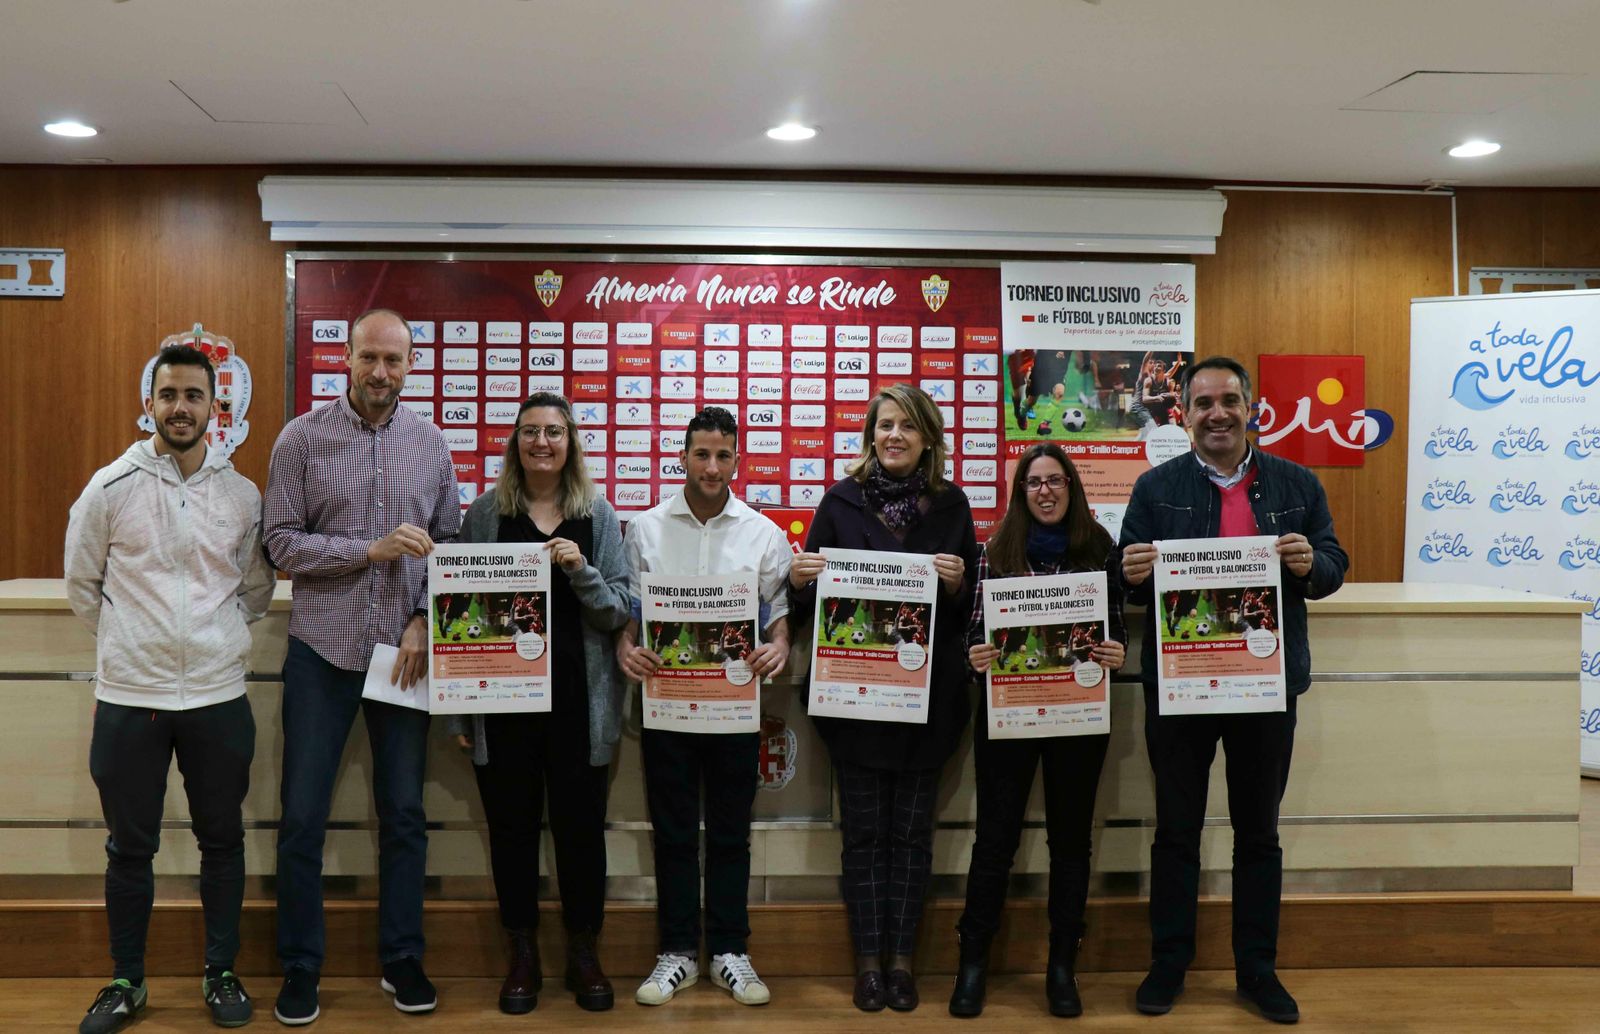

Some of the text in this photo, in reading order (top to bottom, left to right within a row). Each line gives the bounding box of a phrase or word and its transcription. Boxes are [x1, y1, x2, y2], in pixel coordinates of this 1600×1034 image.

[585, 274, 897, 311] Almería Nunca se Rinde
[1007, 285, 1141, 303] TORNEO INCLUSIVO
[1038, 307, 1181, 326] de FÚTBOL y BALONCESTO
[315, 328, 339, 339] CASI
[541, 330, 562, 338] LaLiga
[847, 333, 868, 342] LaLiga
[1063, 327, 1102, 336] Deportistas
[1138, 327, 1181, 336] discapacidad
[1469, 320, 1544, 354] a toda
[499, 356, 520, 364] LaLiga
[531, 356, 555, 366] CASI
[1496, 325, 1600, 389] vela
[804, 360, 825, 368] LaLiga
[838, 361, 861, 370] CASI
[455, 383, 476, 392] LaLiga
[760, 386, 781, 394] LaLiga
[1519, 394, 1586, 404] vida inclusiva
[445, 410, 469, 420] CASI
[750, 413, 773, 422] CASI
[1436, 424, 1457, 436] toda
[1506, 424, 1528, 436] toda
[976, 441, 996, 449] LaLiga
[1439, 427, 1479, 451] vela
[1509, 427, 1550, 451] vela
[1060, 445, 1086, 454] Estadio
[629, 465, 649, 473] LaLiga
[1433, 477, 1455, 488] toda
[1503, 478, 1526, 490] toda
[1437, 480, 1476, 504] vela
[1507, 481, 1548, 506] vela
[1432, 529, 1453, 541] toda
[1501, 532, 1523, 544] toda
[1573, 534, 1597, 547] toda
[1434, 533, 1474, 557] vela
[1504, 535, 1544, 560] vela
[435, 556, 514, 566] TORNEO INCLUSIVO
[1161, 550, 1242, 563] TORNEO INCLUSIVO
[462, 568, 487, 578] FÚTBOL
[493, 569, 537, 577] BALONCESTO
[827, 560, 902, 574] TORNEO INCLUSIVO
[1189, 564, 1215, 574] FÚTBOL
[1221, 563, 1266, 573] BALONCESTO
[851, 575, 875, 585] FÚTBOL
[881, 578, 924, 588] BALONCESTO
[648, 585, 723, 597] TORNEO INCLUSIVO
[991, 587, 1070, 601] TORNEO INCLUSIVO
[672, 600, 697, 608] FÚTBOL
[703, 599, 746, 608] BALONCESTO
[1018, 602, 1043, 612] FÚTBOL
[1050, 599, 1094, 610] BALONCESTO
